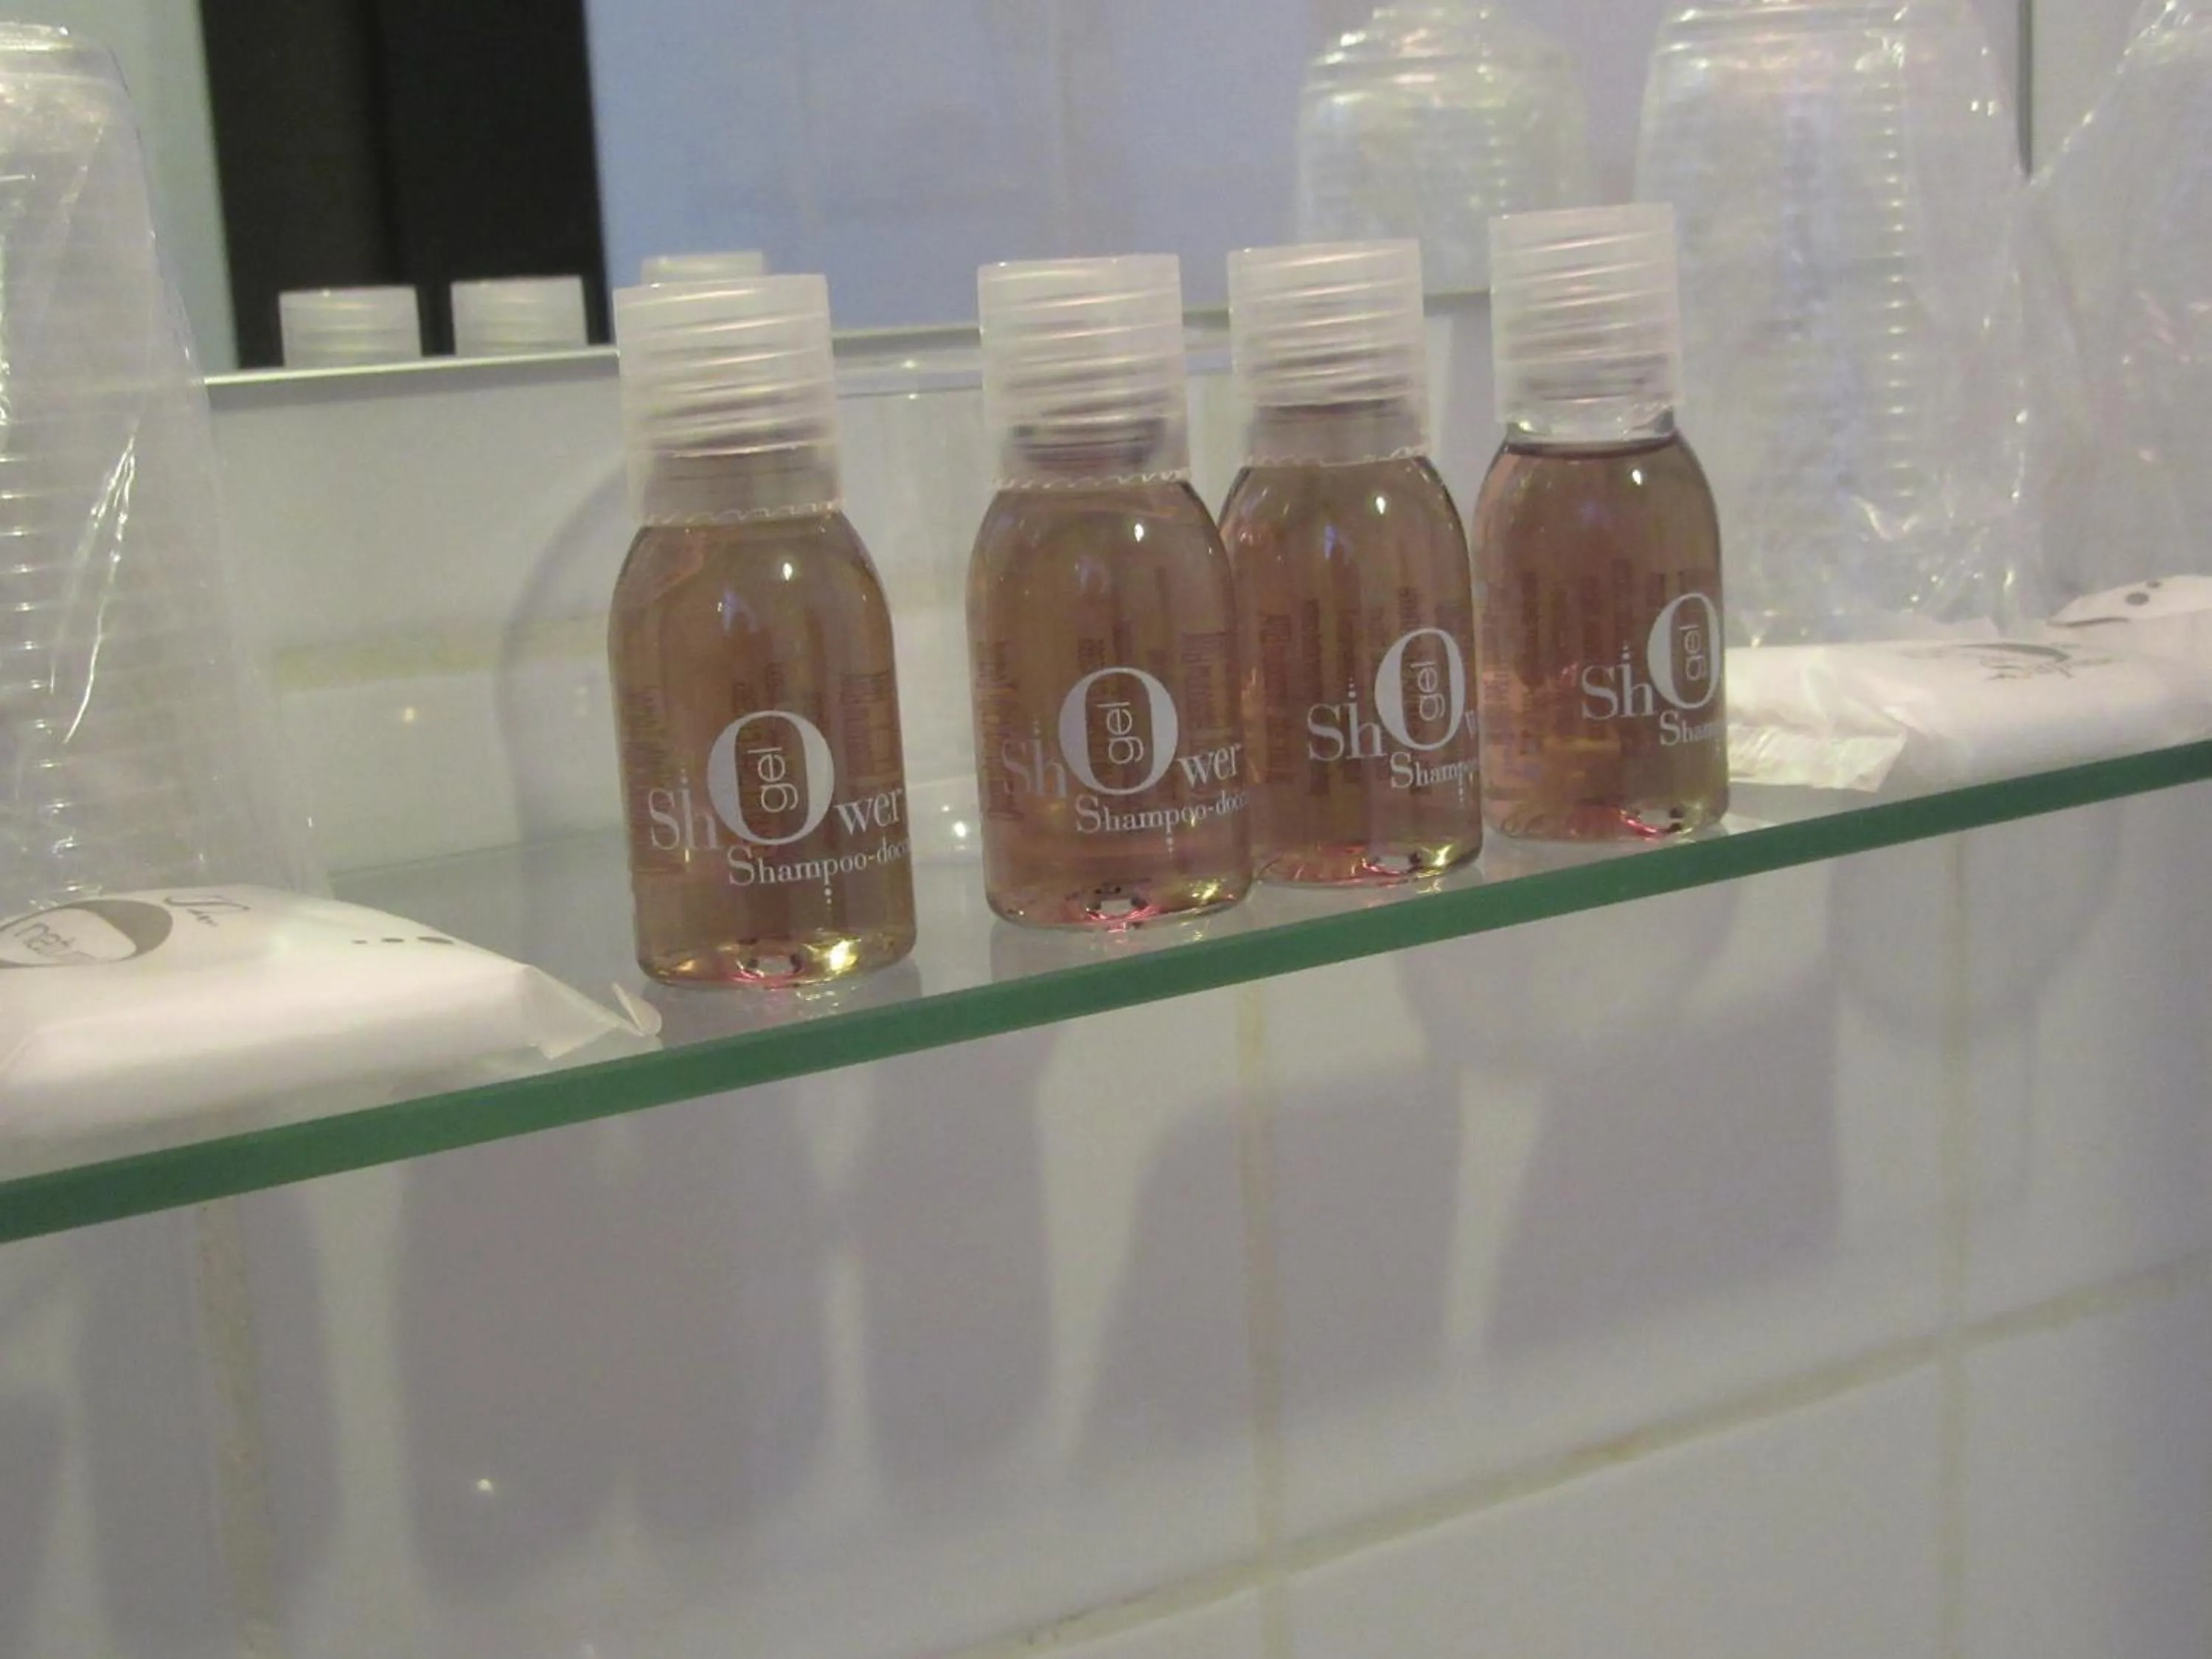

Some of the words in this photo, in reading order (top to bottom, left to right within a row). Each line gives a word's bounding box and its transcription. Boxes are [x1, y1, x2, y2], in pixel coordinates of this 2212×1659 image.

[1410, 660, 1445, 722] gel
[1096, 700, 1144, 765] gel
[746, 745, 799, 813] gel
